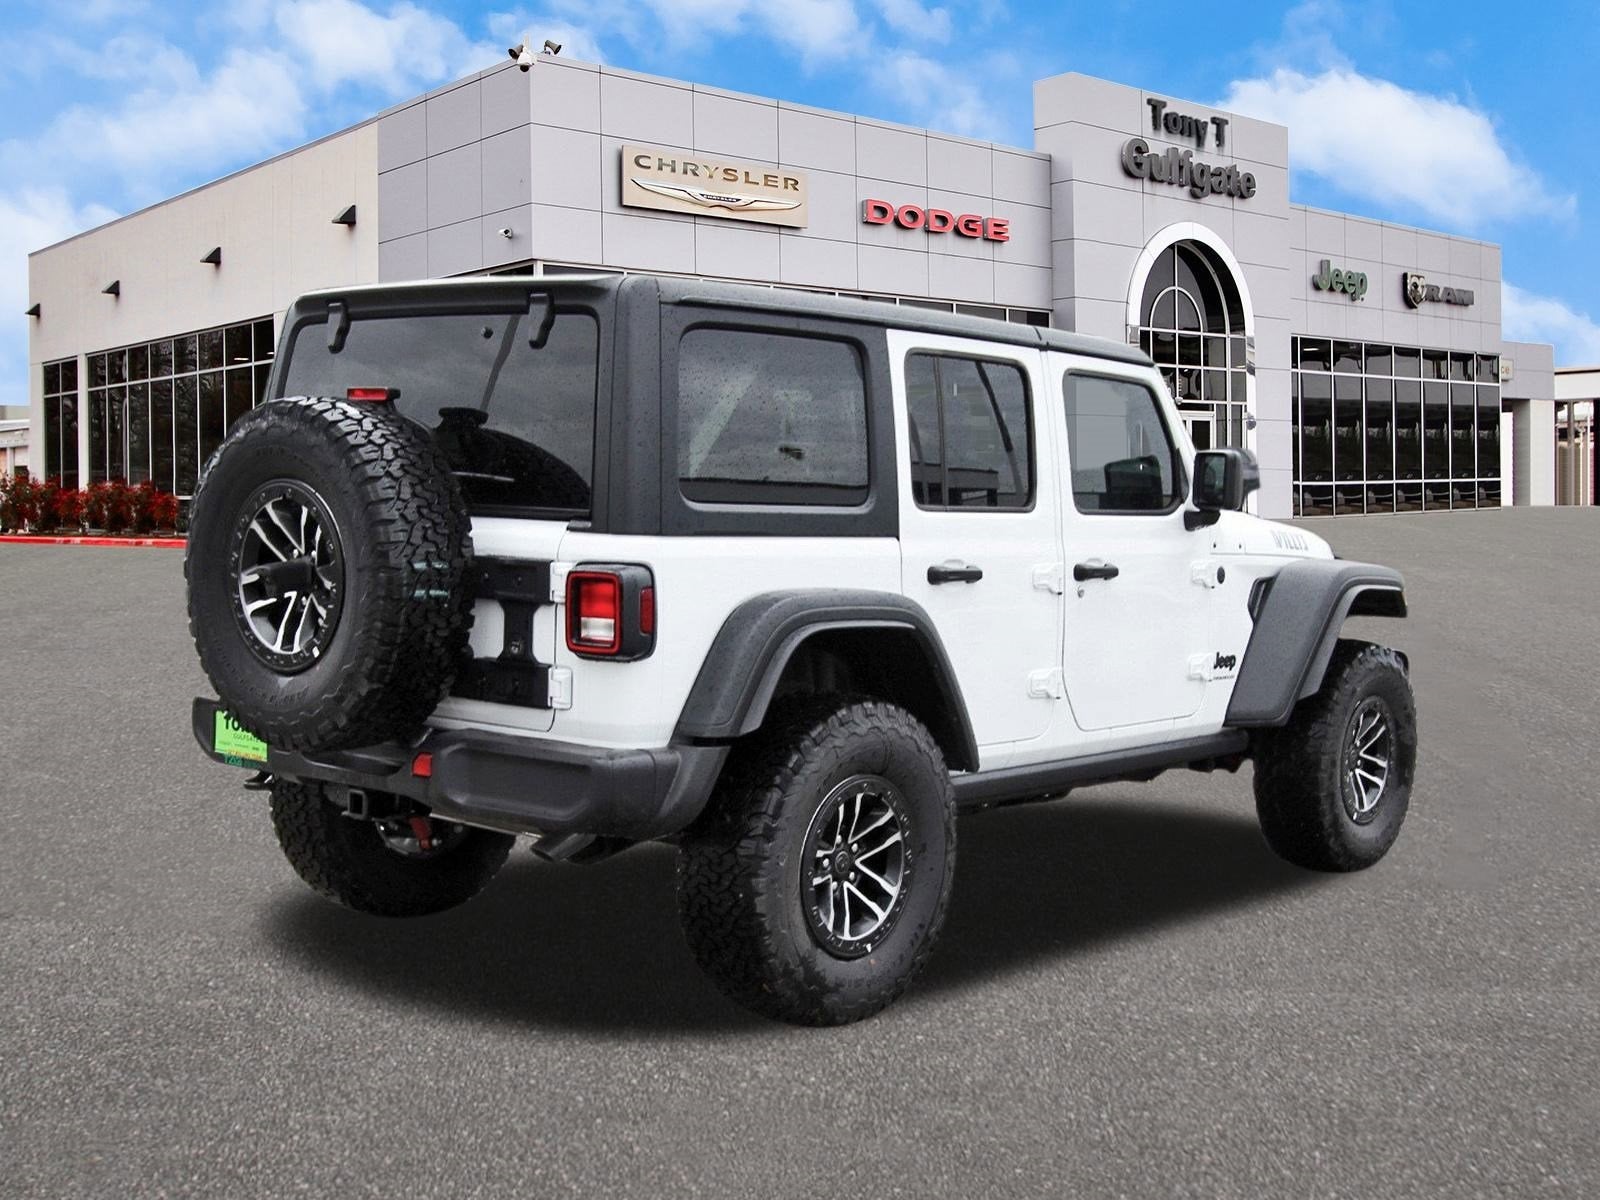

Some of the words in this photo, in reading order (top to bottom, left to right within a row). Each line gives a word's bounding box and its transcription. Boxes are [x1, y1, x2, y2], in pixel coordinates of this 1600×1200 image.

[1146, 98, 1208, 148] Tony
[1210, 116, 1229, 148] T
[633, 154, 800, 191] CHRYSLER
[1121, 138, 1256, 199] Gulfgate
[862, 199, 1010, 242] DODGE
[1312, 259, 1368, 301] Jeep
[1425, 284, 1475, 306] RAM
[1213, 651, 1237, 671] Jeep
